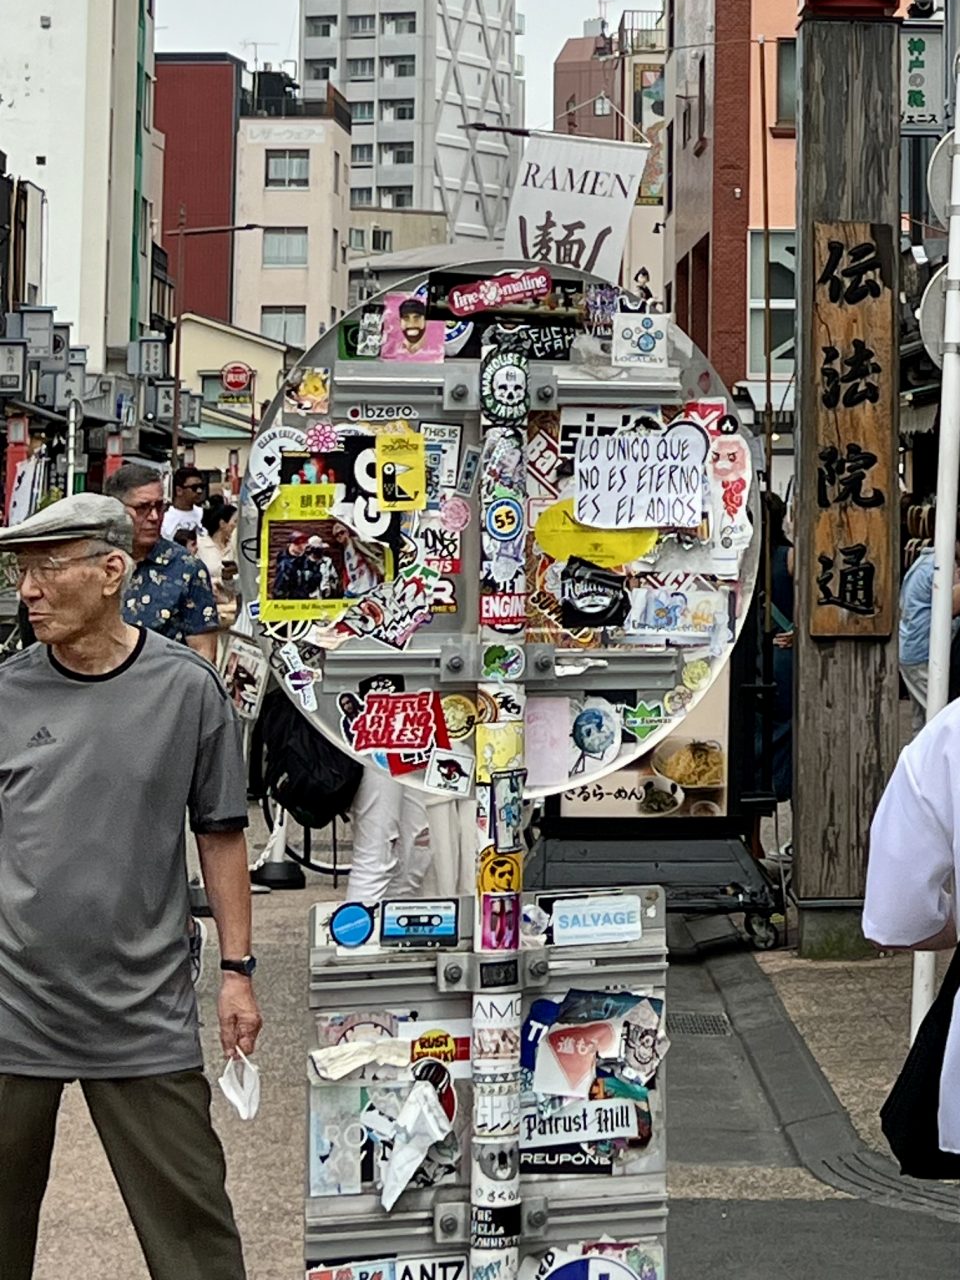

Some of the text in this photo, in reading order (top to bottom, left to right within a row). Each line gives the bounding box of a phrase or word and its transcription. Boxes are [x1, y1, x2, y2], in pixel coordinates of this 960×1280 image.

[521, 161, 635, 198] RAMEN
[816, 240, 885, 616] 伝法院通
[578, 438, 600, 464] LO
[656, 437, 690, 463] QUE
[578, 463, 700, 495] NO ES ETERNO
[494, 509, 516, 529] 55
[577, 493, 601, 521] ES
[615, 495, 635, 526] EL
[558, 910, 637, 929] SALVAGE
